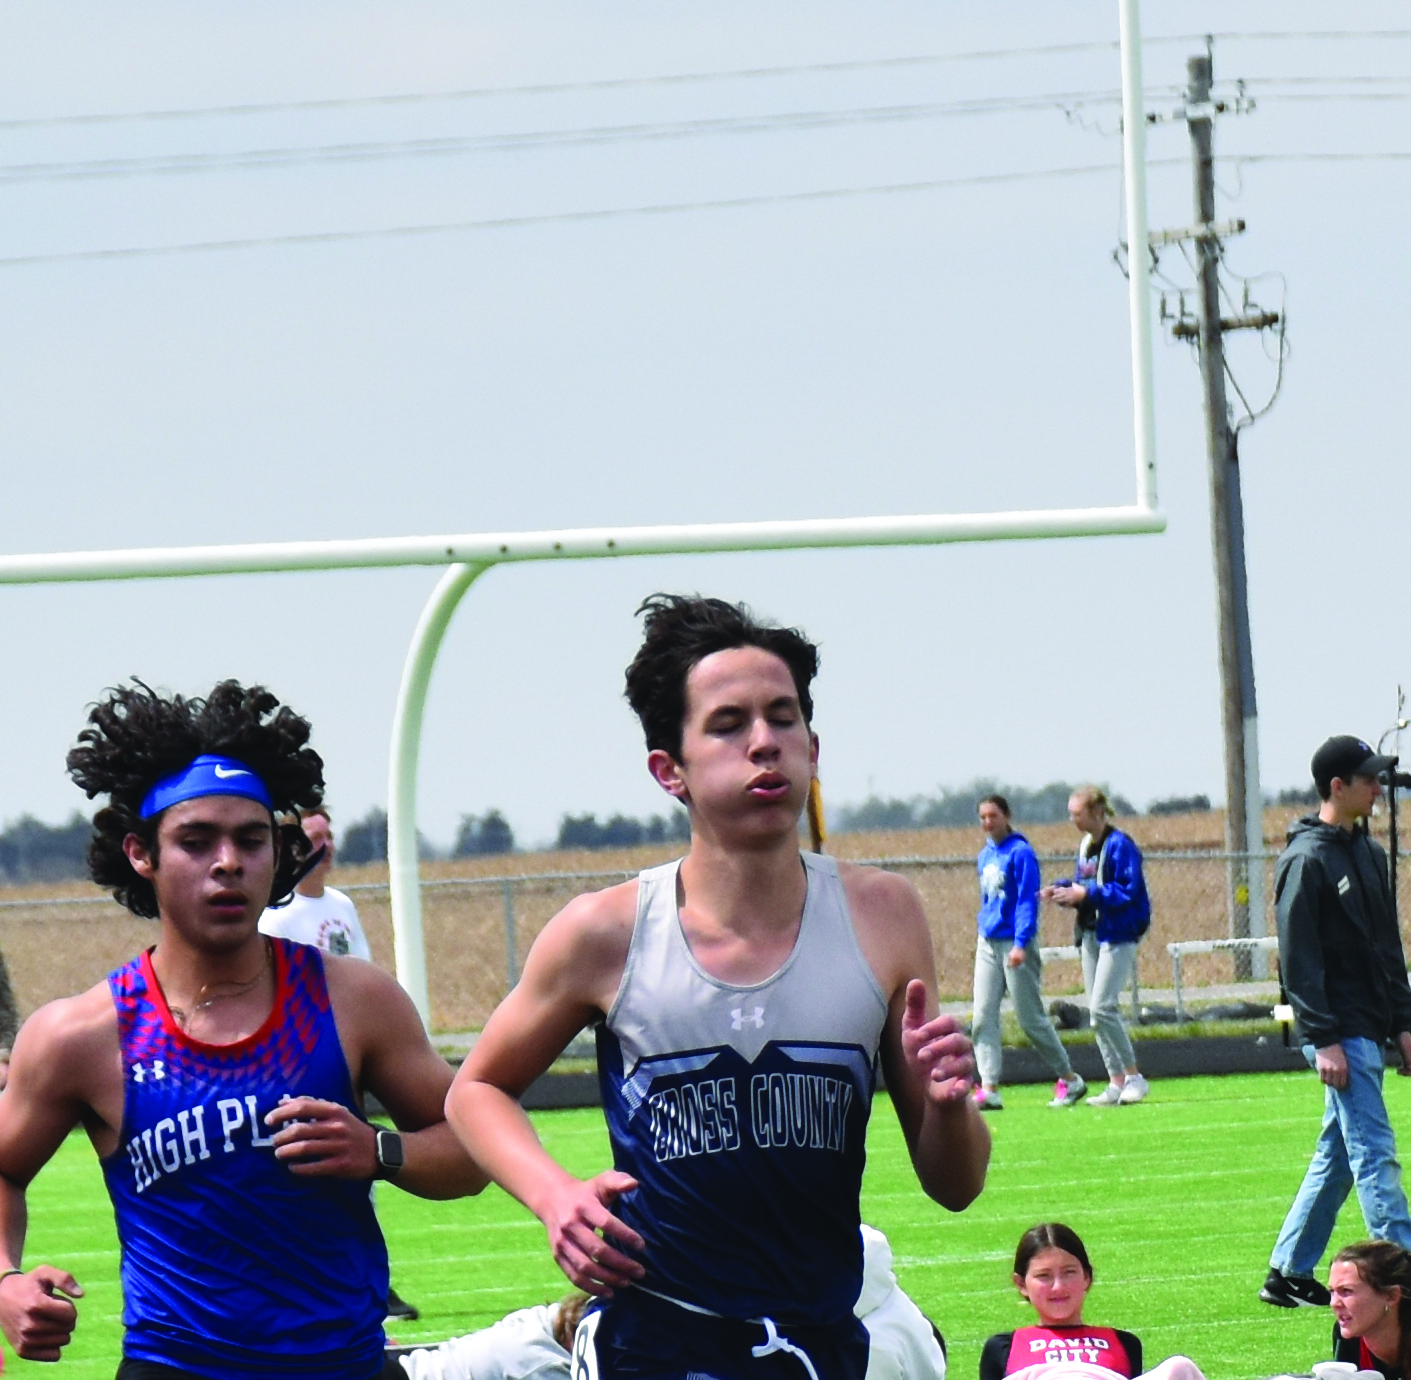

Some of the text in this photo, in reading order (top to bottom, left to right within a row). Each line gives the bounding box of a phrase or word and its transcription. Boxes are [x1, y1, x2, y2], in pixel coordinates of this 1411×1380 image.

[649, 1072, 852, 1163] CROSS COUNTY
[126, 1104, 211, 1194] HIGH
[1029, 1337, 1109, 1353] DAVID
[1044, 1348, 1099, 1363] CITY
